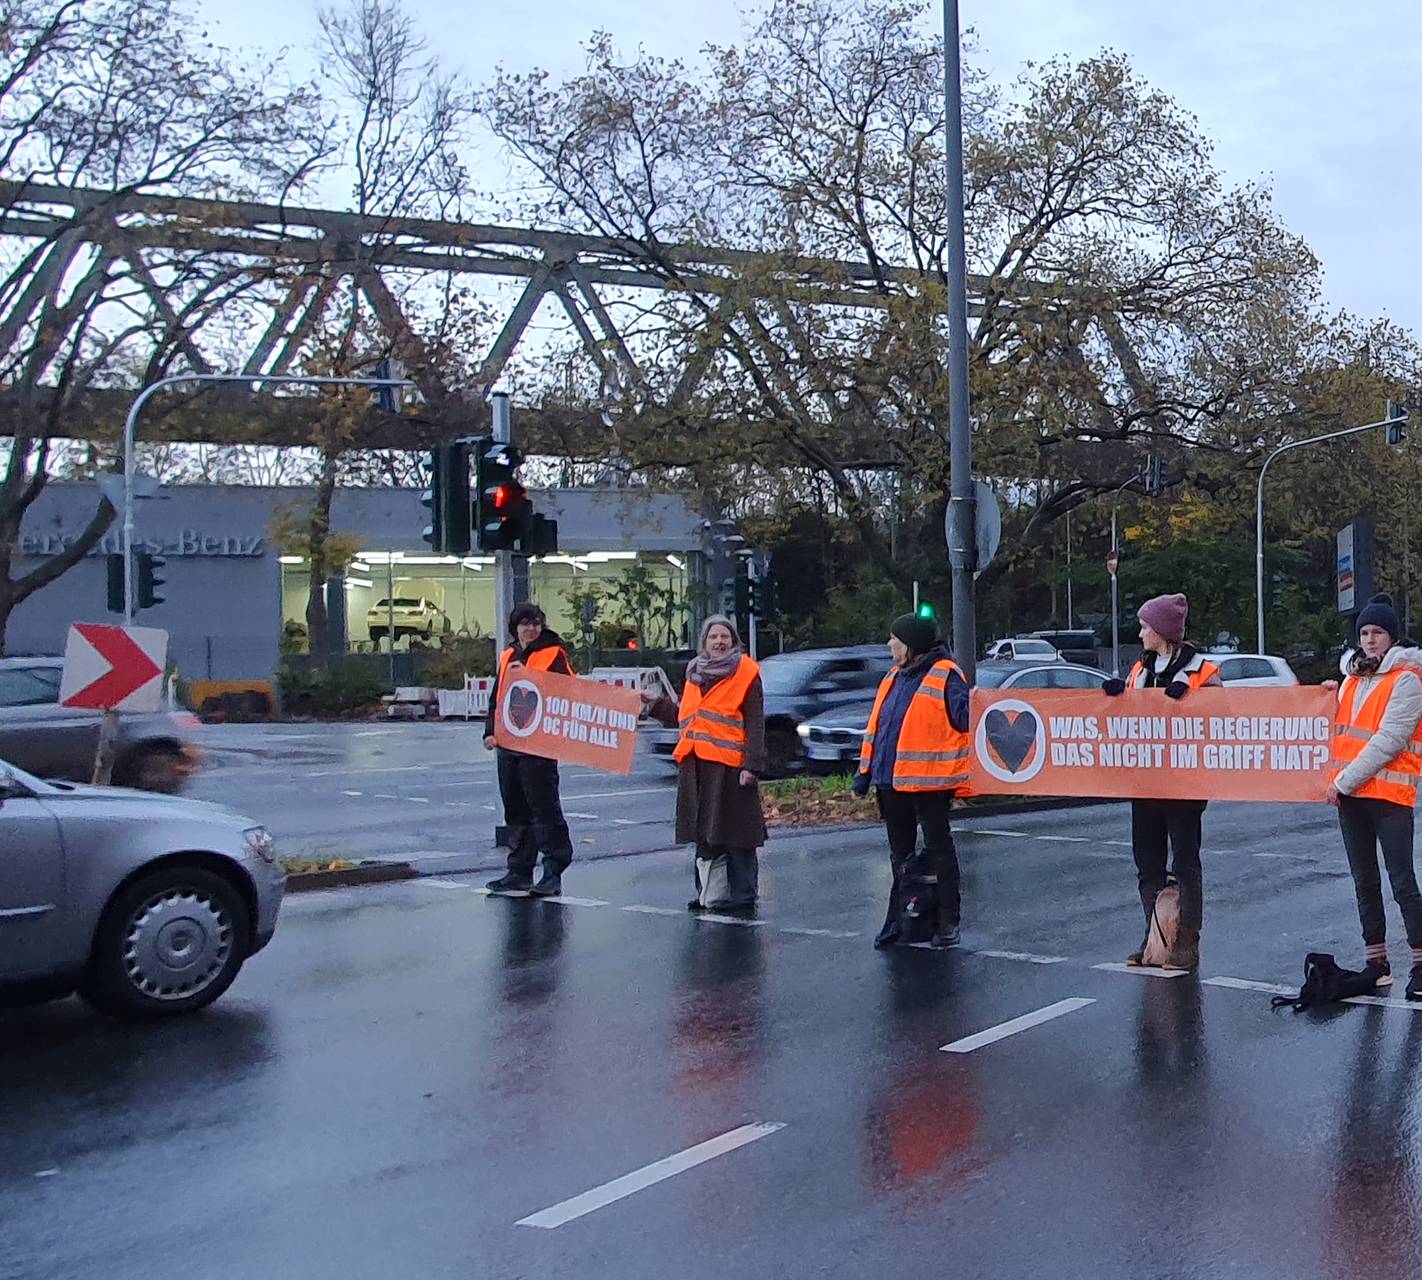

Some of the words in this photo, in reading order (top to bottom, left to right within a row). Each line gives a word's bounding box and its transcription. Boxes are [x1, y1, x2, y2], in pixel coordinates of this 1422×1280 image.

[545, 696, 569, 717] 100
[589, 726, 618, 749] ALLE
[1050, 716, 1103, 741] WAS,
[1106, 716, 1166, 740] WENN
[1171, 717, 1205, 740] DIE
[1209, 717, 1329, 741] REGIERUNG
[1051, 743, 1095, 767] DAS
[1099, 743, 1166, 768] NICHT
[1170, 744, 1198, 769] IM
[1203, 744, 1265, 770] GRIFF
[1270, 744, 1329, 770] HAT?
